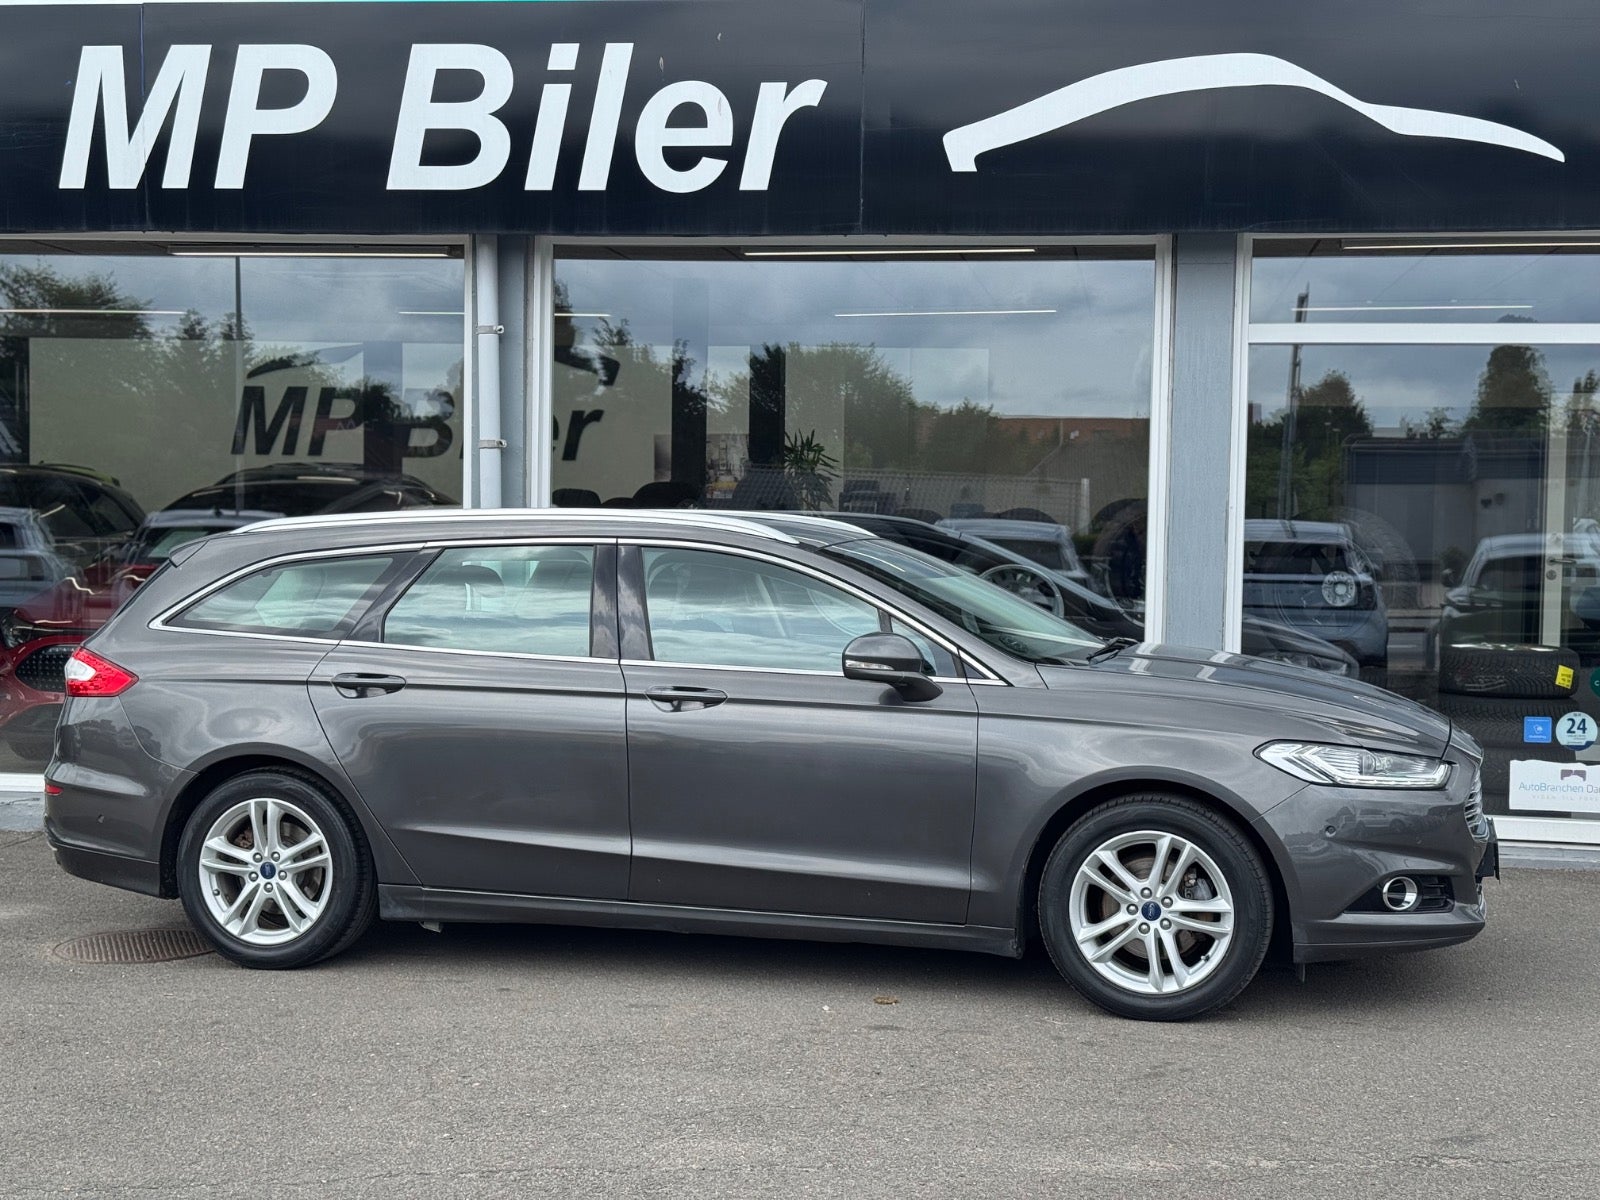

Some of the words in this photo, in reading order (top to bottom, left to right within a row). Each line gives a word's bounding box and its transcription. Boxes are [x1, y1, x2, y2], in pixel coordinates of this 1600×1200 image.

[59, 44, 337, 190] MP
[386, 43, 827, 193] Biler
[1566, 718, 1588, 734] 24
[1519, 782, 1584, 793] AutoBranchen
